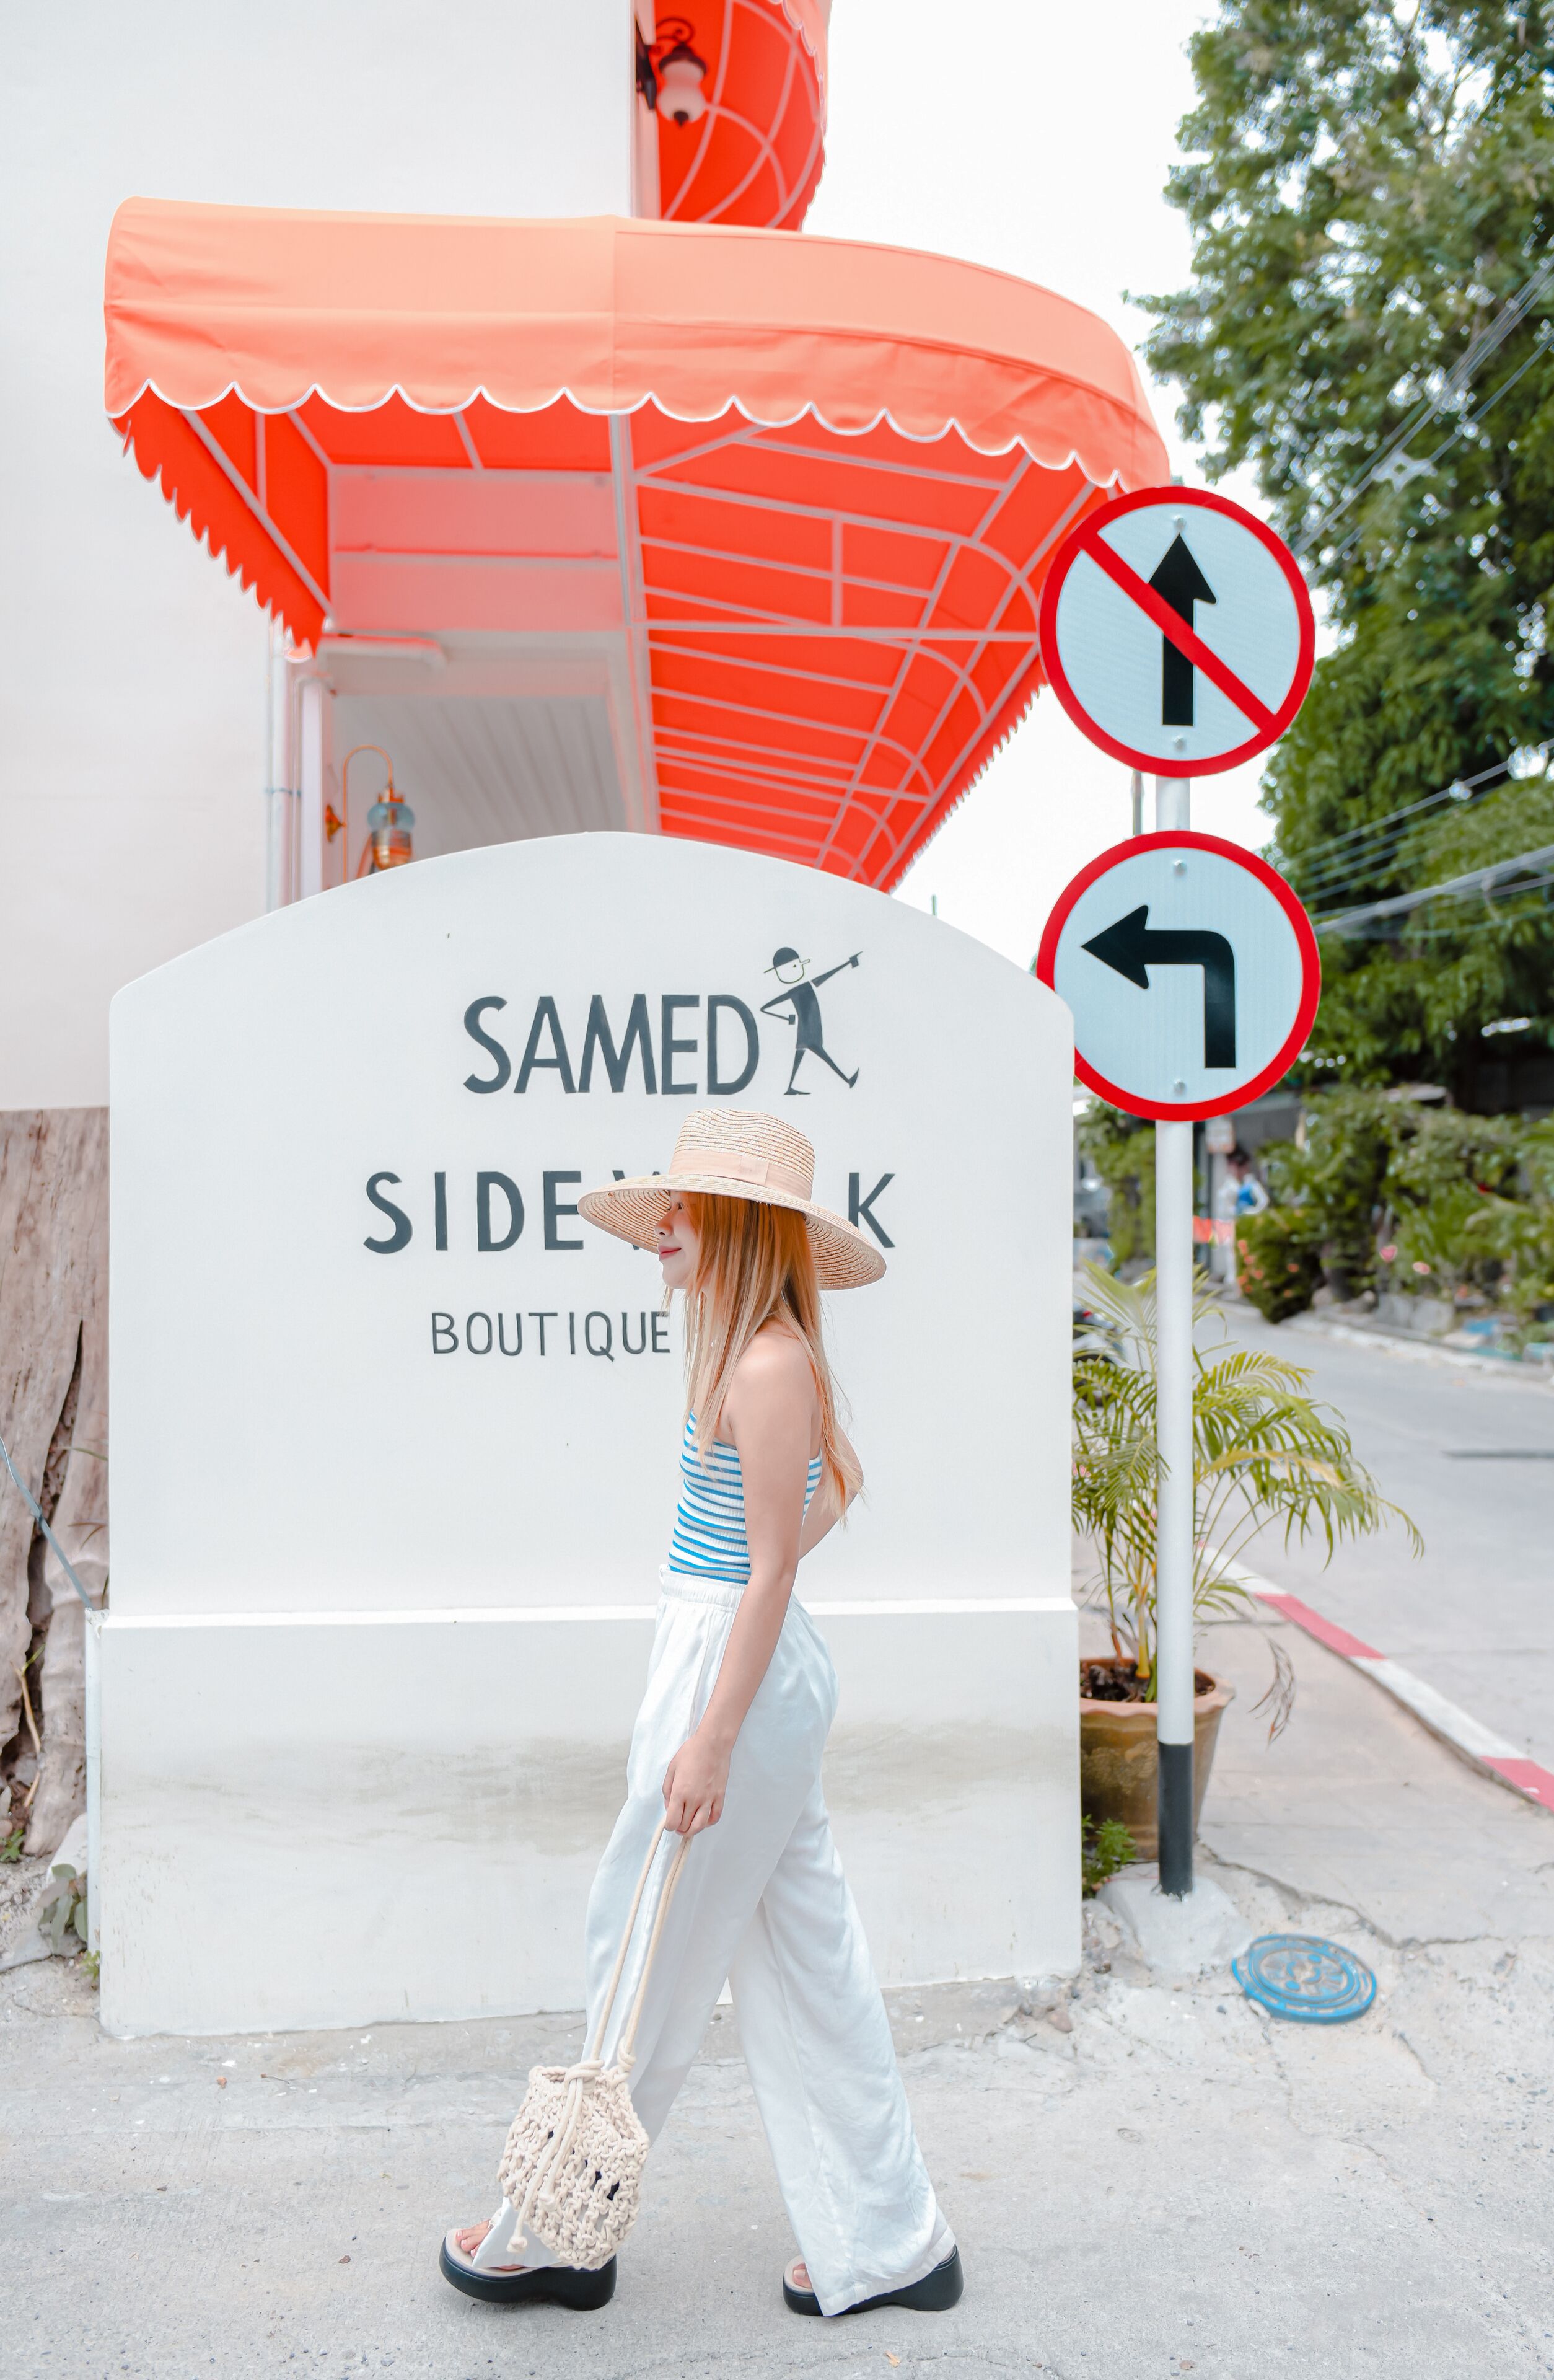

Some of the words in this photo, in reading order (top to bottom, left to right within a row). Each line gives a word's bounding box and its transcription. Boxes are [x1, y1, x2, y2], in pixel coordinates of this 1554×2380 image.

[463, 993, 760, 1095] SAMED
[363, 1170, 896, 1254] SIDEK
[431, 1311, 670, 1362] BOUTIQUE
